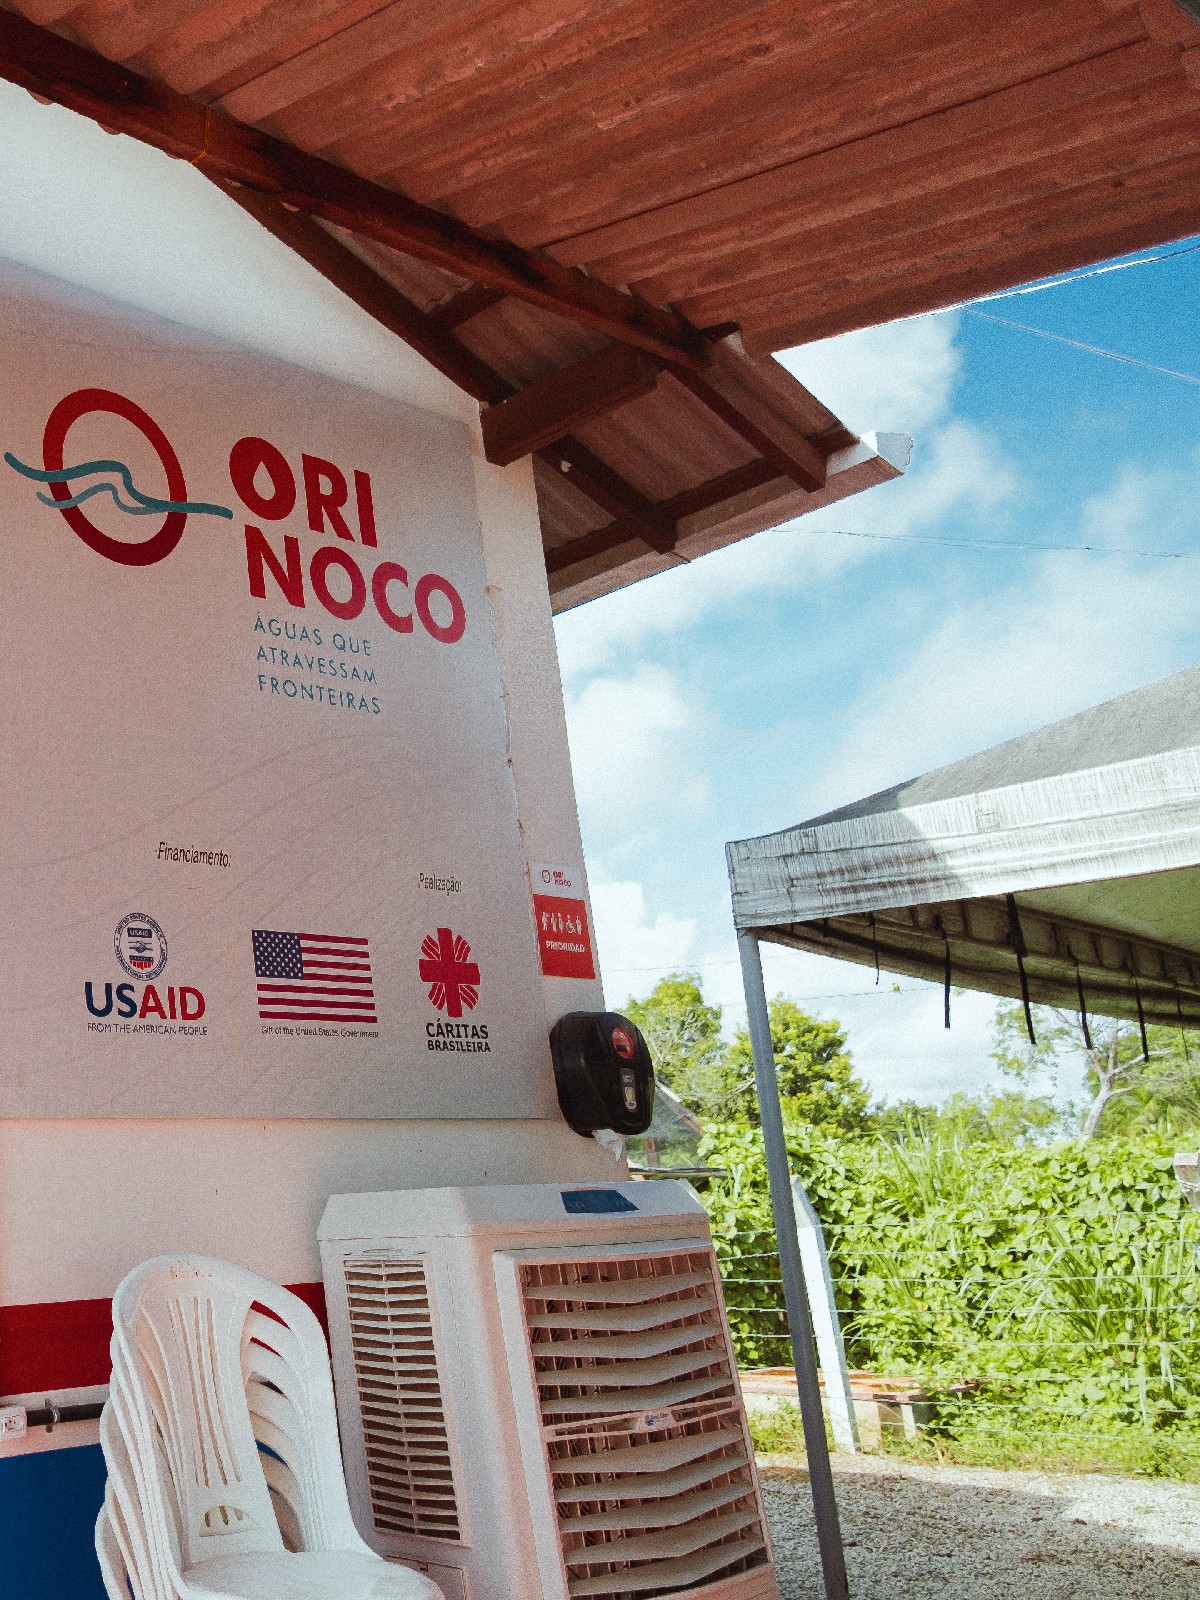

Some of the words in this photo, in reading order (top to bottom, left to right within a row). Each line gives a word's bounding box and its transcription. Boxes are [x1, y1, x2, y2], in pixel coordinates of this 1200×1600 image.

[229, 437, 378, 548] ORI
[244, 524, 466, 644] NOCO
[254, 612, 323, 646] ÁGUAS
[332, 633, 371, 656] QUE
[256, 648, 377, 684] ATRAVESSAM
[258, 674, 381, 714] FRONTEIRAS
[158, 842, 231, 867] Financiamento:
[419, 873, 462, 896] Realização:
[546, 940, 584, 953] PRIORIDAD
[85, 981, 206, 1020] USAID
[87, 1022, 112, 1034] FROM
[113, 1023, 131, 1034] THE
[132, 1025, 176, 1035] AMERICAN
[178, 1025, 208, 1036] PEOPLE
[261, 1025, 273, 1035] Gift
[275, 1026, 282, 1035] of
[283, 1026, 294, 1036] the
[296, 1026, 317, 1037] United
[318, 1027, 339, 1038] States
[341, 1028, 379, 1038] Government
[426, 1018, 489, 1039] CÁRITAS
[427, 1040, 491, 1053] BRASILEIRA
